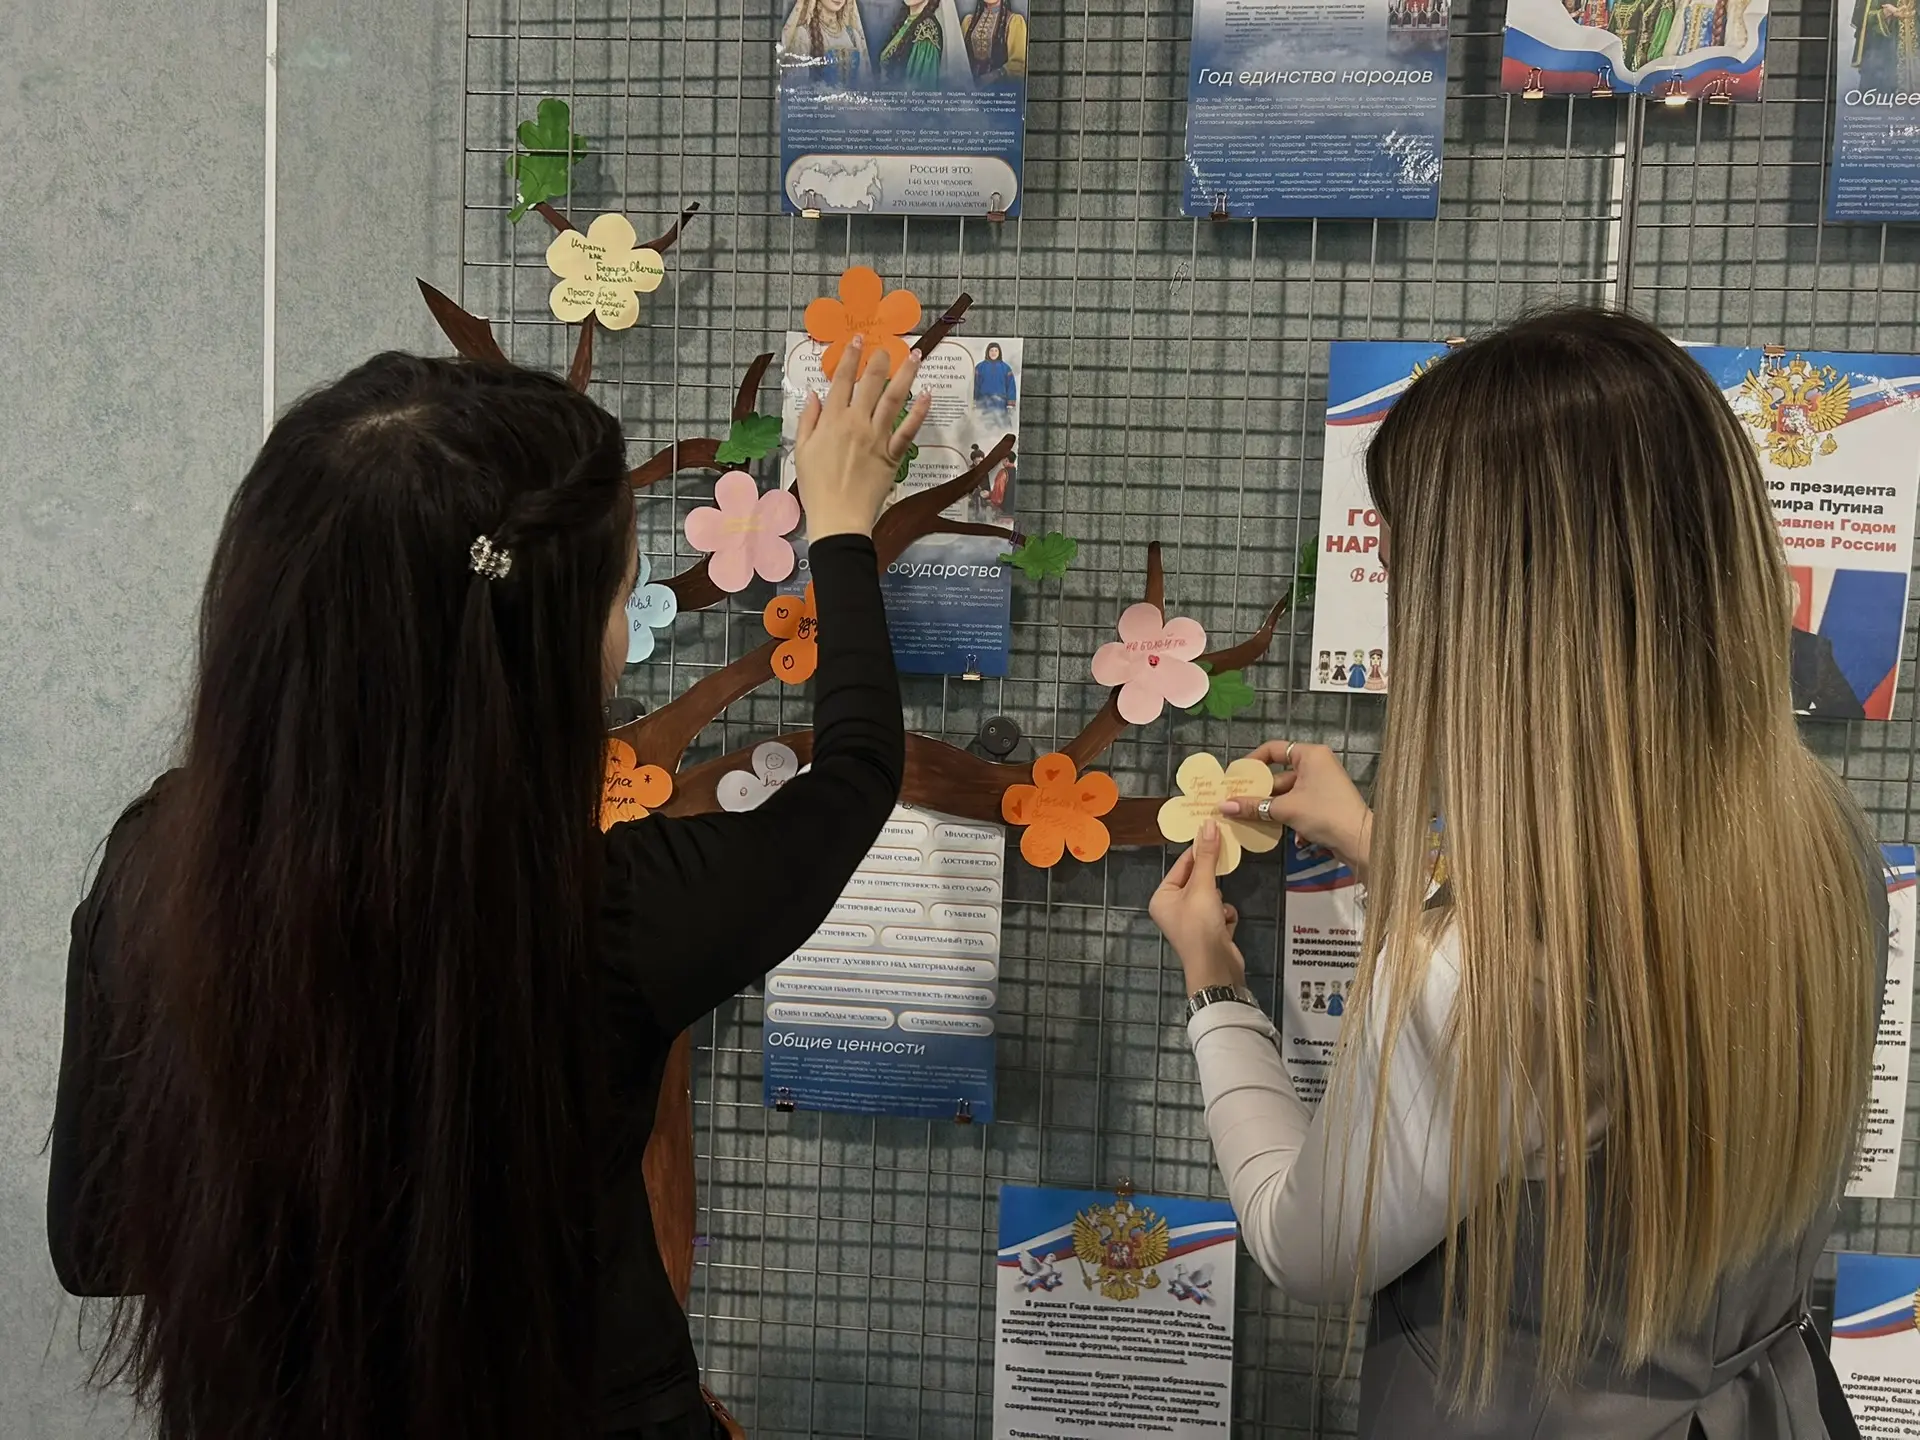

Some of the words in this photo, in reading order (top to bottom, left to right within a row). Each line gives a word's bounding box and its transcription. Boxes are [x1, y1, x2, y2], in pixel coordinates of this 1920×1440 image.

[1198, 68, 1233, 87] Год
[1239, 70, 1336, 86] единства
[1341, 70, 1433, 87] народов
[1844, 88, 1920, 108] Общее
[910, 164, 948, 174] Россия
[951, 166, 973, 174] это:
[904, 189, 929, 197] более
[946, 191, 980, 199] народов
[892, 199, 907, 207] 270
[945, 201, 987, 209] диалектов
[571, 238, 606, 253] Играть
[567, 287, 595, 298] Просто
[1790, 481, 1896, 497] президента
[1771, 499, 1814, 512] мира
[1819, 499, 1884, 515] Путина
[1347, 509, 1380, 526] ГО
[1840, 519, 1896, 535] Годом
[1326, 535, 1378, 553] НАР
[1784, 536, 1825, 549] одов
[1831, 536, 1897, 552] России
[887, 562, 1002, 579] осударства
[1350, 567, 1365, 583] В
[880, 827, 914, 835] тивизм
[944, 830, 996, 841] Милосердие
[940, 856, 997, 867] Достоинство
[874, 880, 940, 890] ответственность
[966, 885, 993, 893] судьбу
[884, 906, 916, 914] идеалы
[944, 909, 986, 919] Гуманизм
[1293, 925, 1320, 935] Цель
[1329, 928, 1356, 936] этого
[895, 933, 962, 944] Созидательный
[964, 938, 984, 947] труд
[792, 954, 841, 965] Приоритет
[842, 958, 888, 968] духовного
[890, 961, 907, 969] над
[908, 962, 975, 973] материальным
[776, 981, 832, 992] Историческая
[833, 985, 863, 994] память
[871, 988, 943, 999] преемственность
[944, 992, 988, 1002] поколений
[774, 1008, 800, 1017] Права
[809, 1010, 847, 1021] свободы
[847, 1014, 887, 1022] человека
[911, 1016, 982, 1029] Справедливость
[768, 1032, 833, 1050] Общие
[836, 1037, 926, 1056] ценности
[1033, 1301, 1067, 1309] рамках
[1069, 1302, 1091, 1311] Года
[1093, 1305, 1135, 1313] единства
[1137, 1307, 1175, 1317] народов
[1177, 1310, 1211, 1320] России
[1001, 1318, 1045, 1326] включает
[1047, 1320, 1097, 1329] фестивали
[1099, 1323, 1145, 1333] народных
[1147, 1327, 1186, 1338] культур,
[1010, 1309, 1067, 1318] планируется
[1069, 1312, 1109, 1321] широкая
[1111, 1315, 1161, 1325] программа
[1163, 1319, 1205, 1329] событий.
[1207, 1323, 1226, 1331] Она
[1002, 1328, 1048, 1338] концерты,
[1050, 1331, 1109, 1340] театральные
[1111, 1335, 1152, 1344] проекты,
[1162, 1338, 1190, 1347] также
[1010, 1337, 1077, 1347] общественные
[1079, 1341, 1119, 1351] форумы,
[1188, 1350, 1232, 1360] вопросам
[1045, 1350, 1132, 1360] межнациональных
[1134, 1355, 1187, 1365] отношений.
[1005, 1364, 1045, 1374] Большое
[1048, 1369, 1092, 1377] внимание
[1095, 1371, 1120, 1379] будет
[1122, 1374, 1160, 1383] уделено
[1163, 1376, 1227, 1388] образованию.
[1851, 1372, 1880, 1382] Среди
[1016, 1375, 1088, 1386] Запланированы
[1091, 1380, 1131, 1390] проекты,
[1133, 1385, 1201, 1395] направленные
[1842, 1383, 1912, 1394] проживающих
[1011, 1384, 1054, 1393] изучение
[1057, 1388, 1089, 1396] языков
[1092, 1391, 1129, 1399] народов
[1132, 1392, 1167, 1403] России,
[1170, 1397, 1220, 1408] поддержку
[1031, 1395, 1105, 1407] многоязыкового
[1107, 1400, 1153, 1411] обучения,
[1155, 1405, 1199, 1414] создание
[1864, 1405, 1915, 1416] украинцы,
[1004, 1402, 1066, 1413] современных
[1068, 1407, 1108, 1416] учебных
[1110, 1411, 1164, 1420] материалов
[1180, 1417, 1217, 1426] истории
[1055, 1416, 1096, 1426] культуре
[1098, 1419, 1135, 1429] народов
[1137, 1423, 1174, 1432] страны.
[1859, 1424, 1900, 1433] сийской
